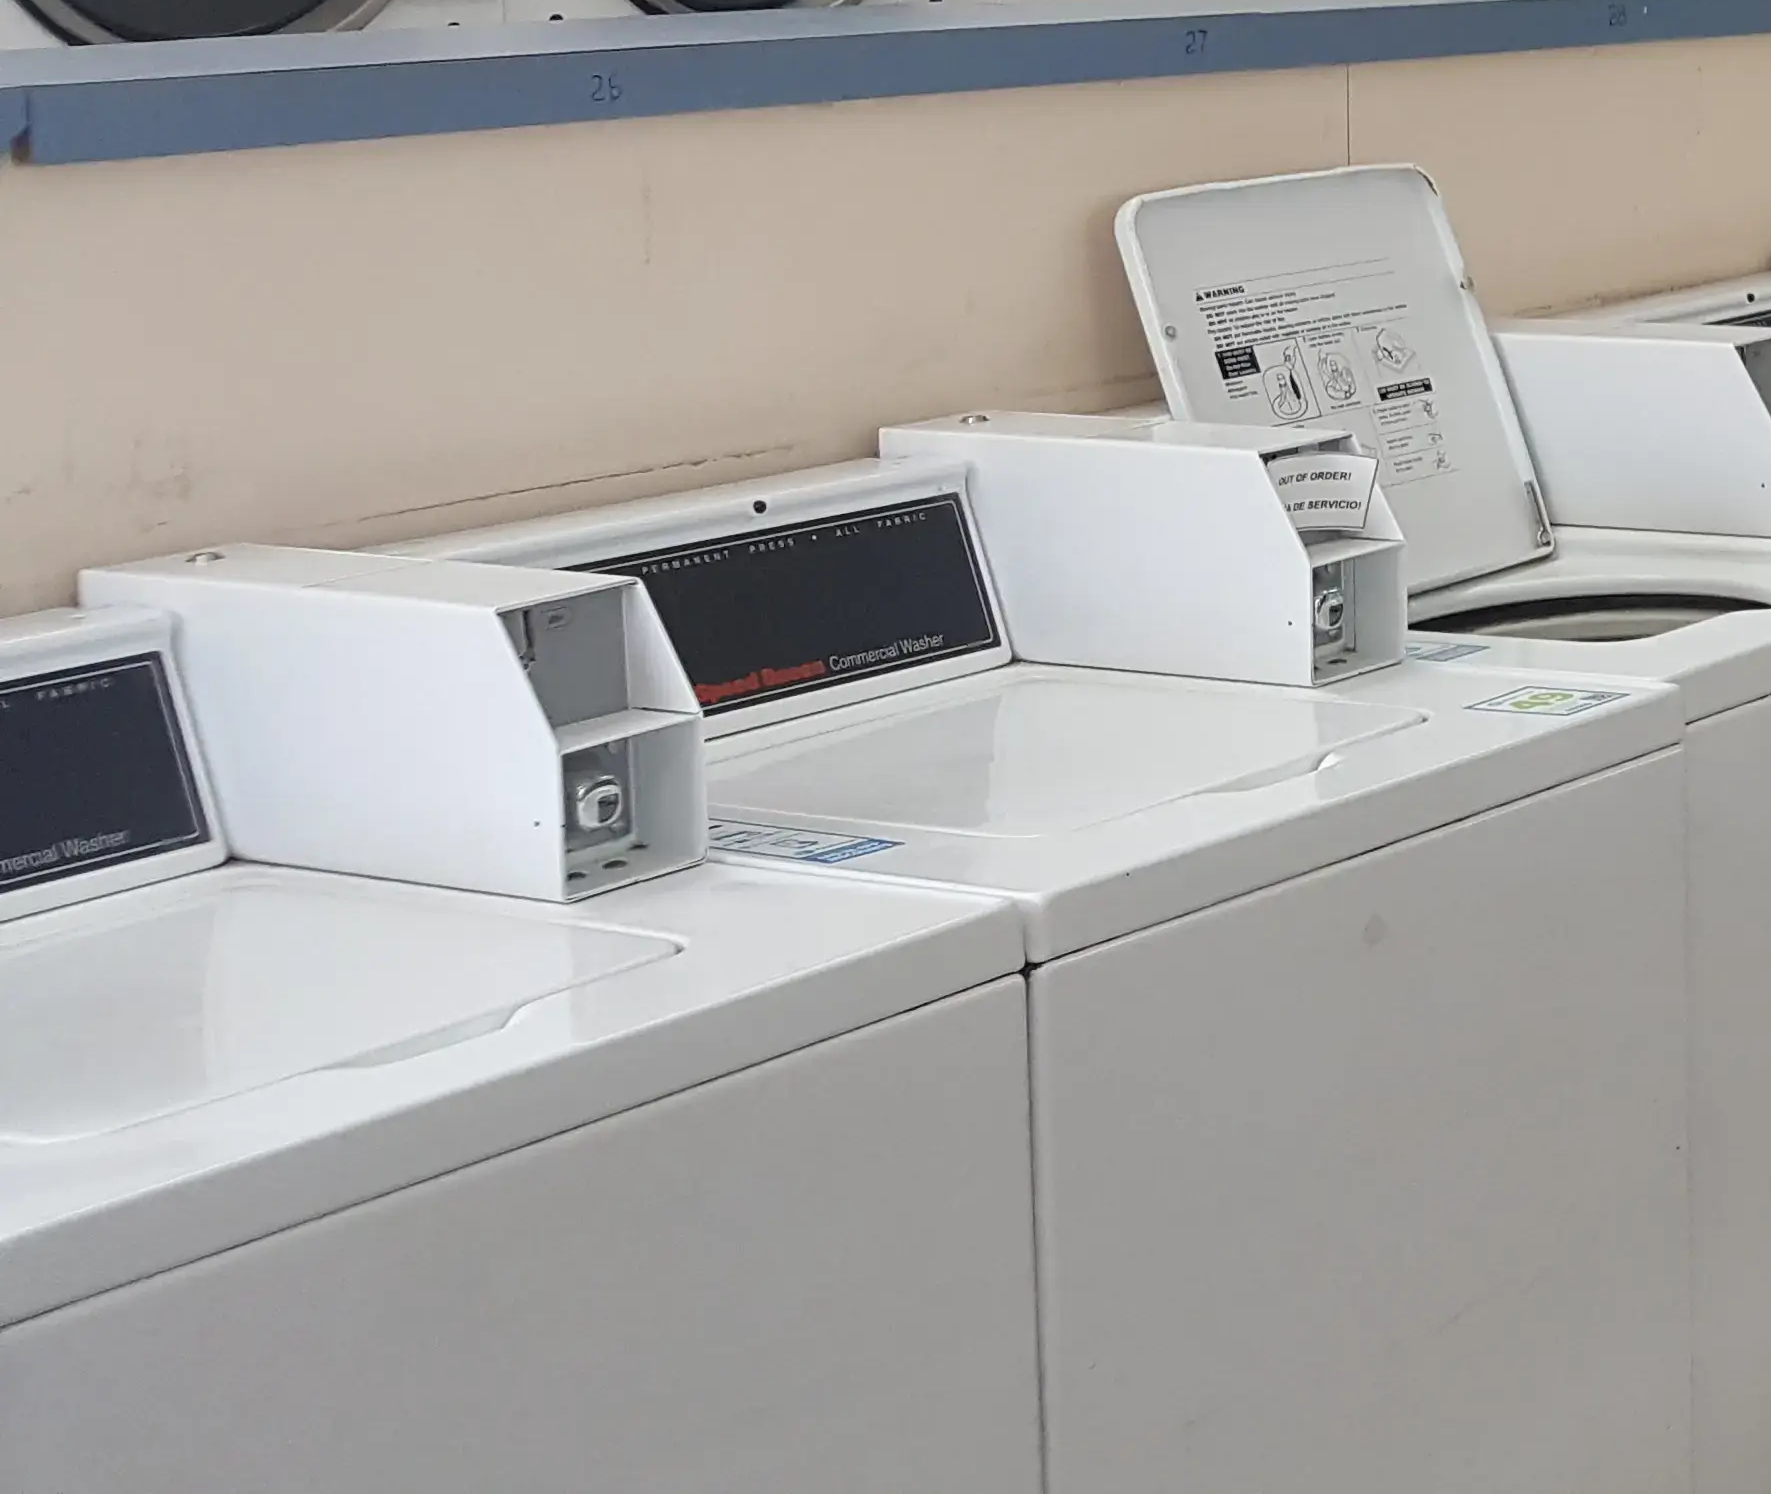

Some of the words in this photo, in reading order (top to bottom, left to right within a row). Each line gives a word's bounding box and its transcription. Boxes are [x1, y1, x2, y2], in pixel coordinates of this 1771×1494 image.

[1185, 29, 1208, 54] 27
[1203, 285, 1246, 300] WARNING
[1278, 474, 1294, 486] OUT
[1295, 472, 1308, 483] OF
[1310, 471, 1352, 481] ORDER!
[1293, 502, 1305, 512] DE
[1307, 500, 1362, 511] SERVICIO!
[641, 550, 730, 574] PERMANENT
[749, 537, 796, 553] PRESS
[836, 525, 861, 537] ALL
[877, 512, 928, 528] FABRIC
[829, 642, 899, 671] Commercial
[900, 633, 945, 655] Washer
[36, 677, 115, 702] FABRIC
[61, 829, 131, 859] Washer
